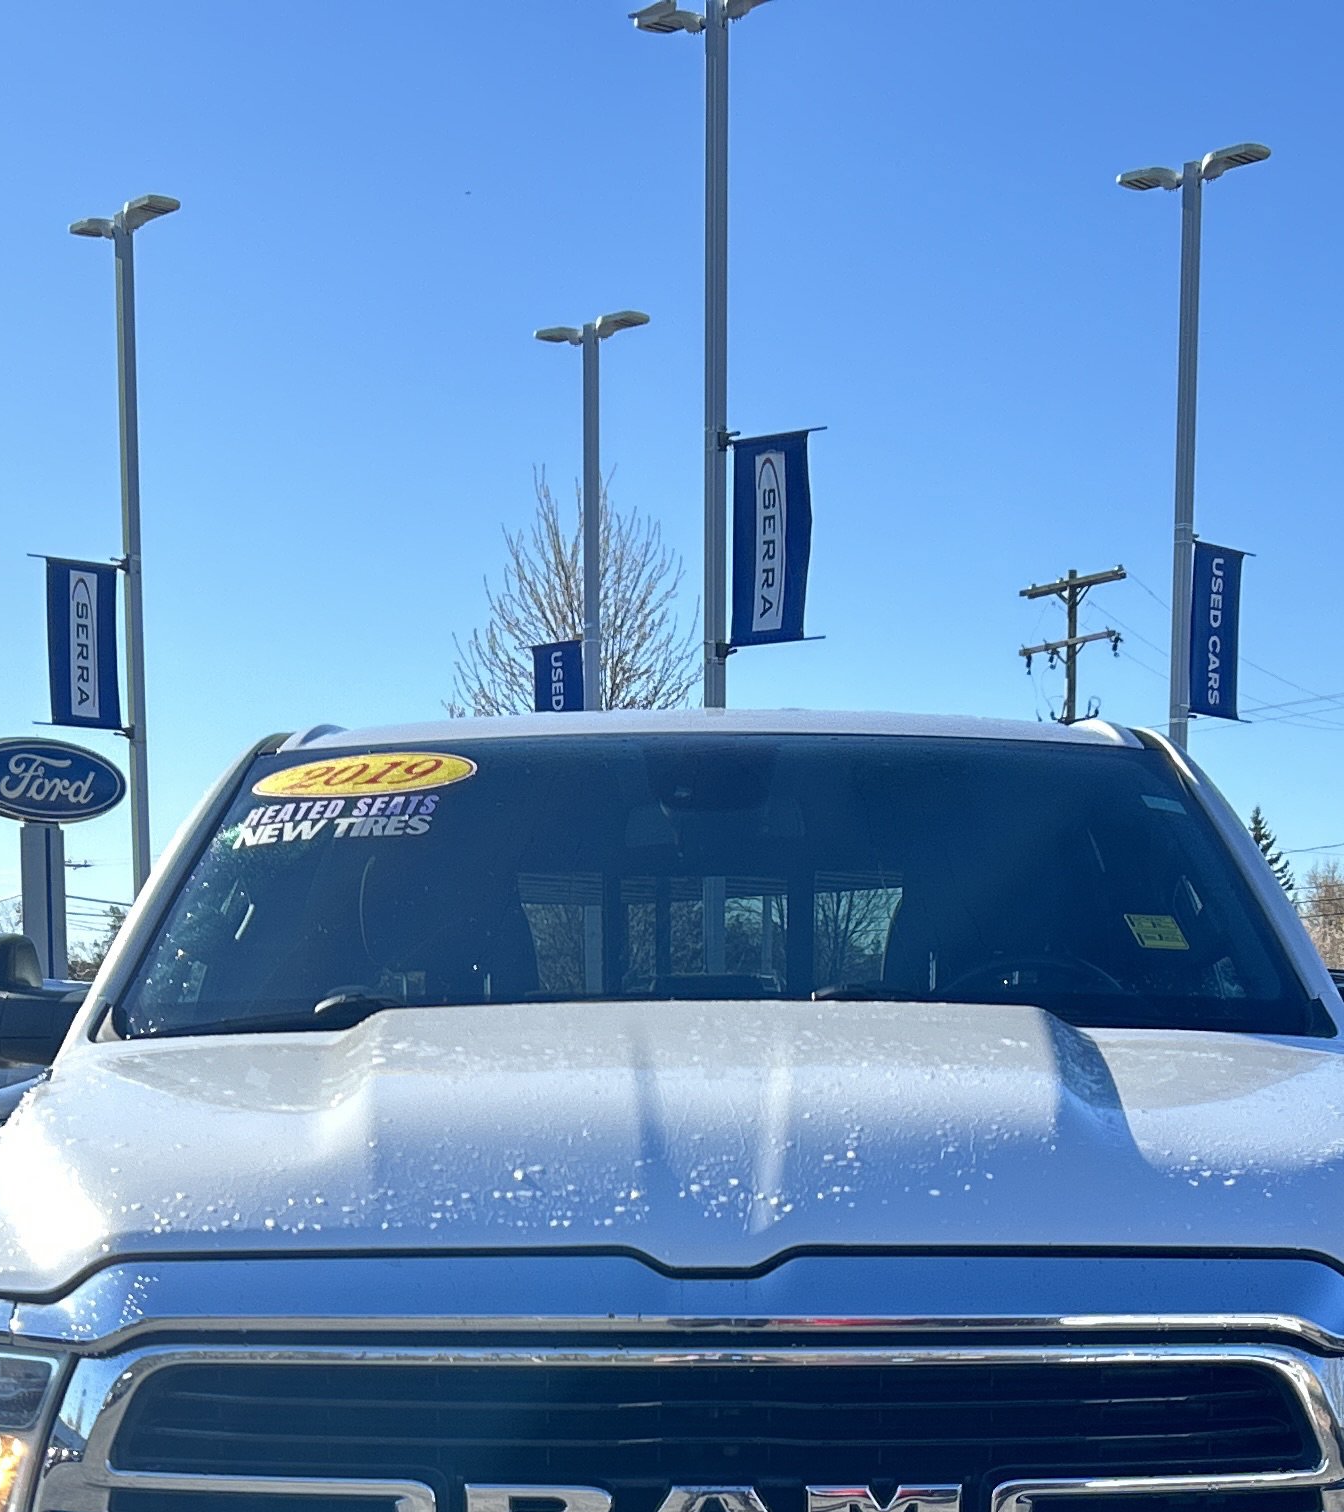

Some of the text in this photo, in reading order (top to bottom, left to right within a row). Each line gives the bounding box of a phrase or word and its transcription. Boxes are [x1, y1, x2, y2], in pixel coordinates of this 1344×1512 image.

[759, 488, 776, 619] SERRA
[76, 601, 90, 706] SERRA
[1207, 557, 1224, 705] USED CARS
[551, 651, 564, 711] USED
[0, 753, 96, 805] Ford
[285, 758, 444, 791] 2019
[231, 814, 433, 850] NEW TIRES
[244, 795, 440, 827] HEATED SEATS
